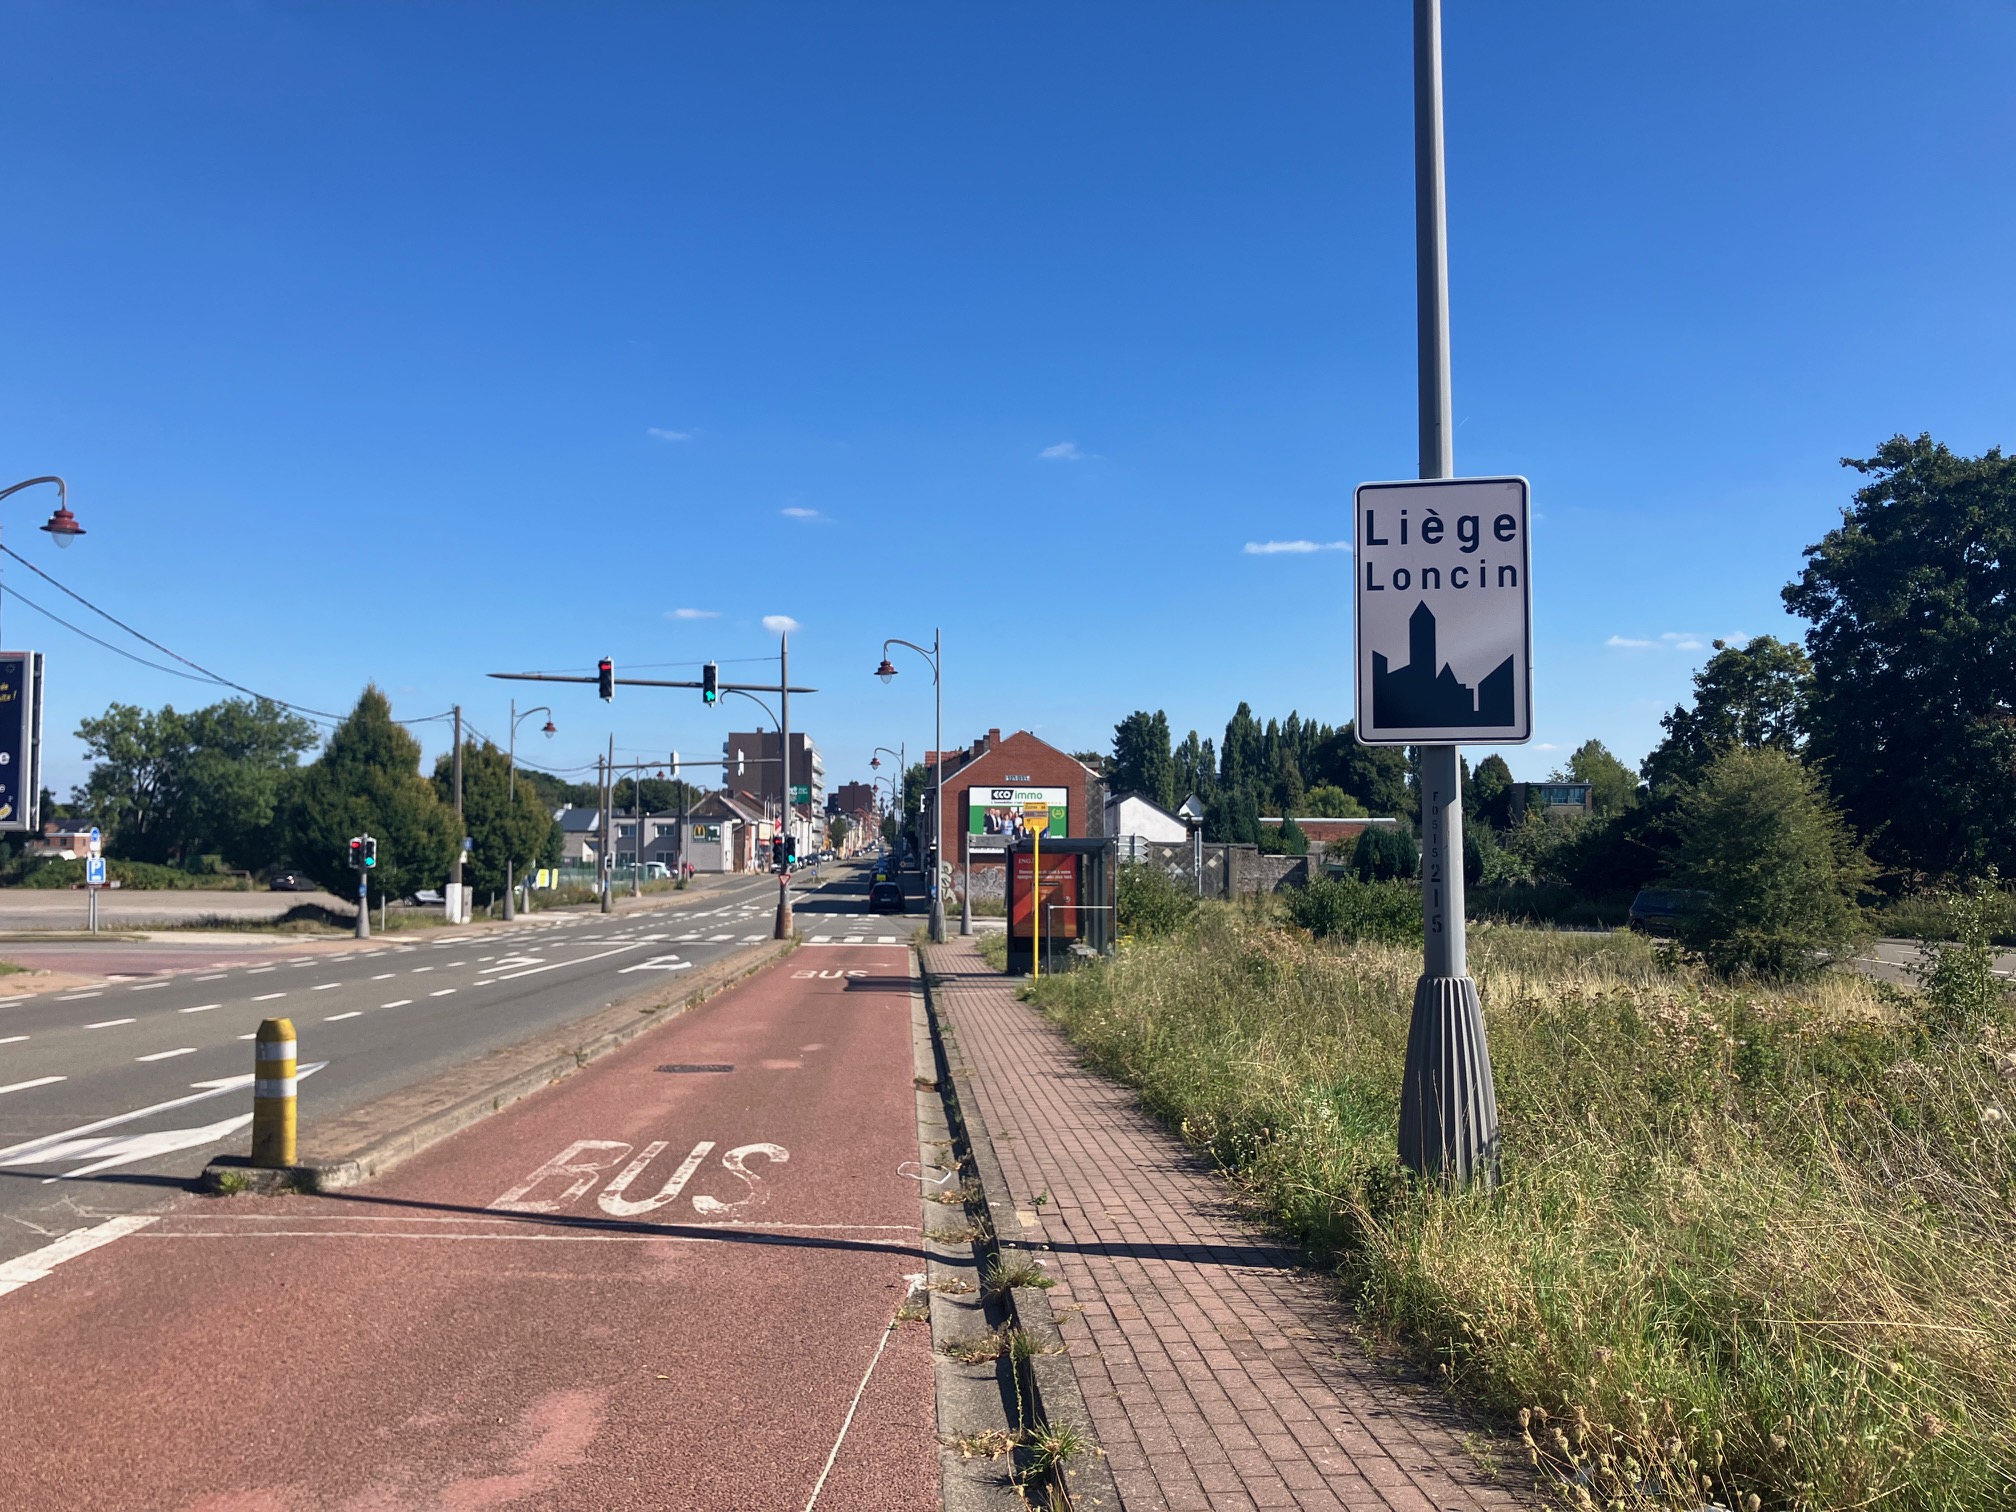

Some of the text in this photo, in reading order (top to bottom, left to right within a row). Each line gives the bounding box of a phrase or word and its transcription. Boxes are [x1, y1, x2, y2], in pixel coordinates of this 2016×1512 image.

[1366, 508, 1516, 554] Liège
[1366, 559, 1517, 591] Loncin
[1014, 791, 1043, 800] immo
[790, 969, 869, 980] BUS
[485, 1139, 790, 1217] BUS
